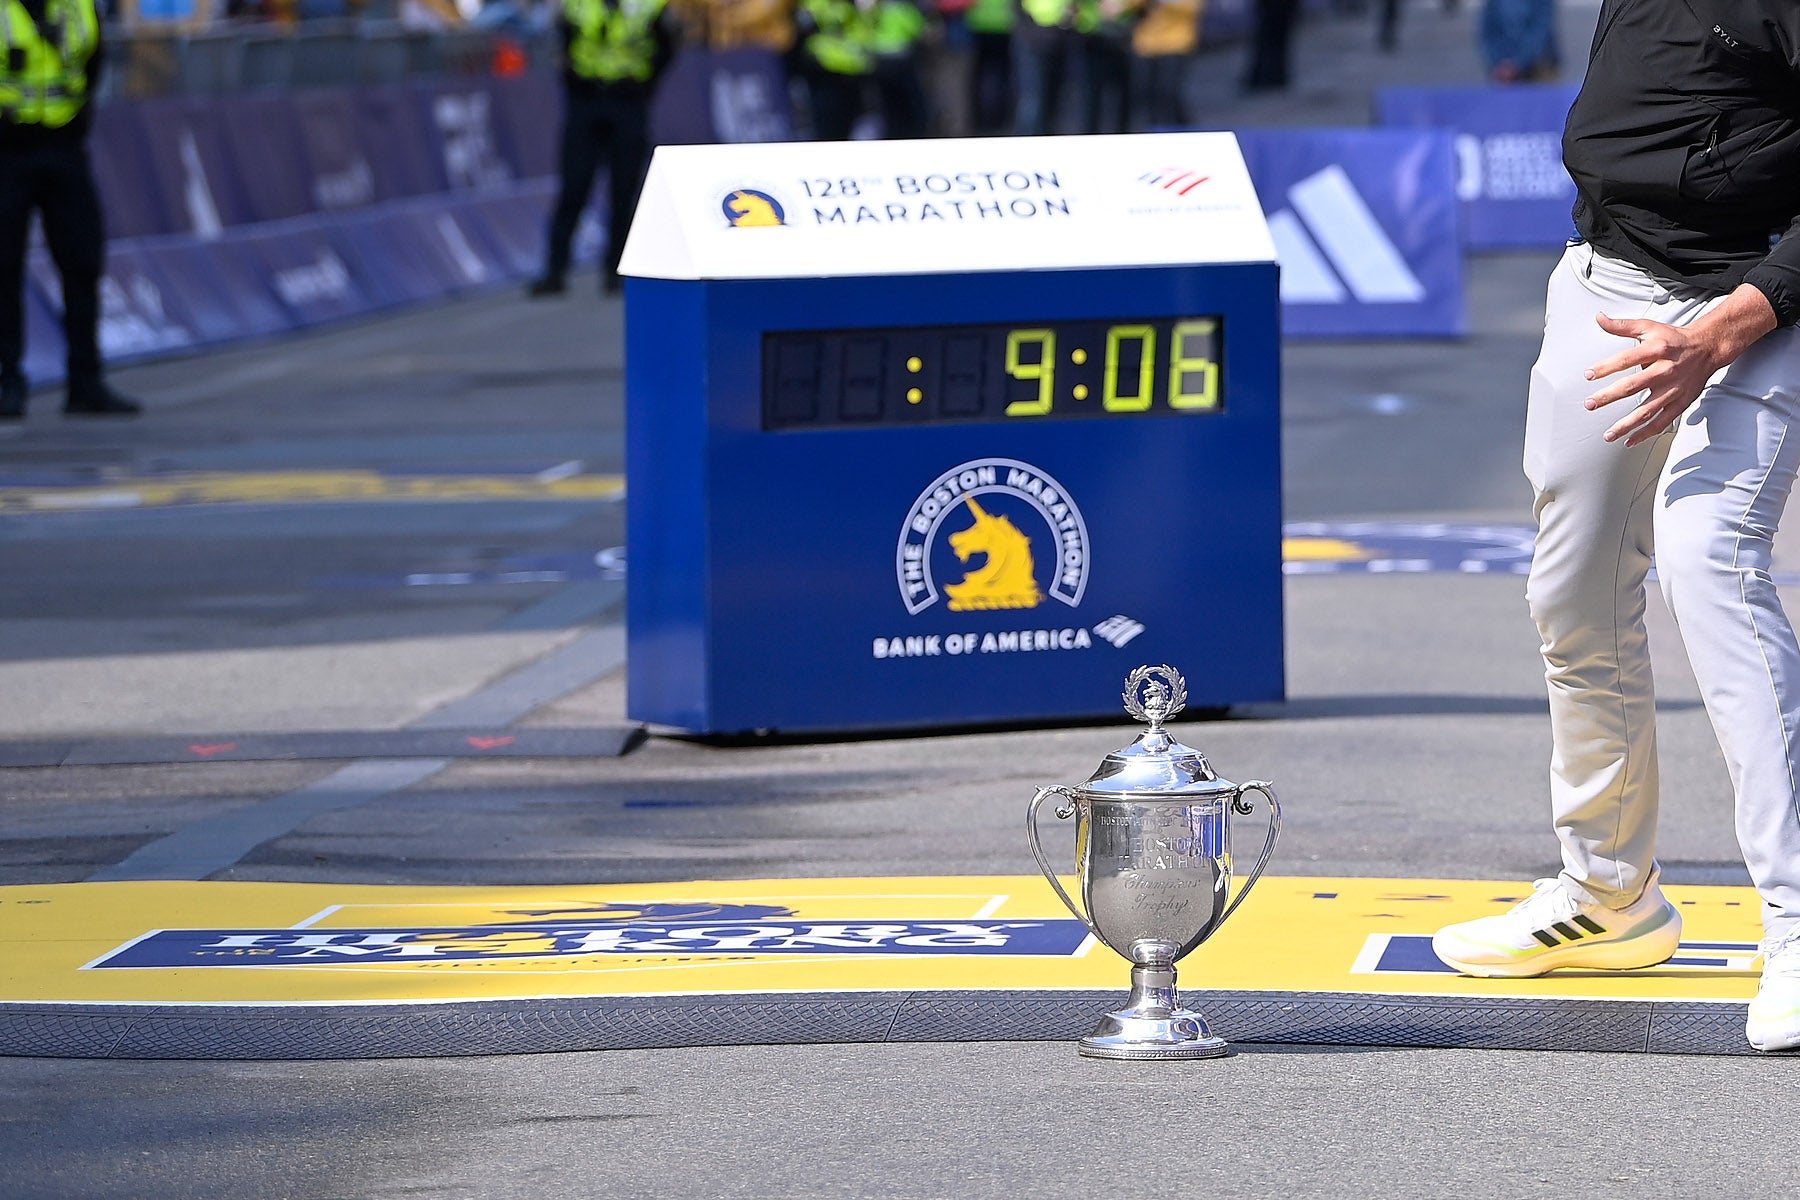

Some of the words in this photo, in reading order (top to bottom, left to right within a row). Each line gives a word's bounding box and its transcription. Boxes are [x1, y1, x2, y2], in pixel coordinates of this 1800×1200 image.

[1713, 24, 1739, 48] BYLT
[896, 170, 1062, 196] BOSTON
[812, 198, 1072, 226] MARATHON
[1004, 321, 1220, 417] 9:06
[911, 465, 997, 536] BOSTON
[1006, 467, 1083, 591] MARATHON
[903, 542, 926, 599] THE
[872, 635, 942, 659] BANK
[944, 632, 979, 655] OF
[980, 628, 1092, 653] AMERICA
[1131, 893, 1189, 917] Trophy
